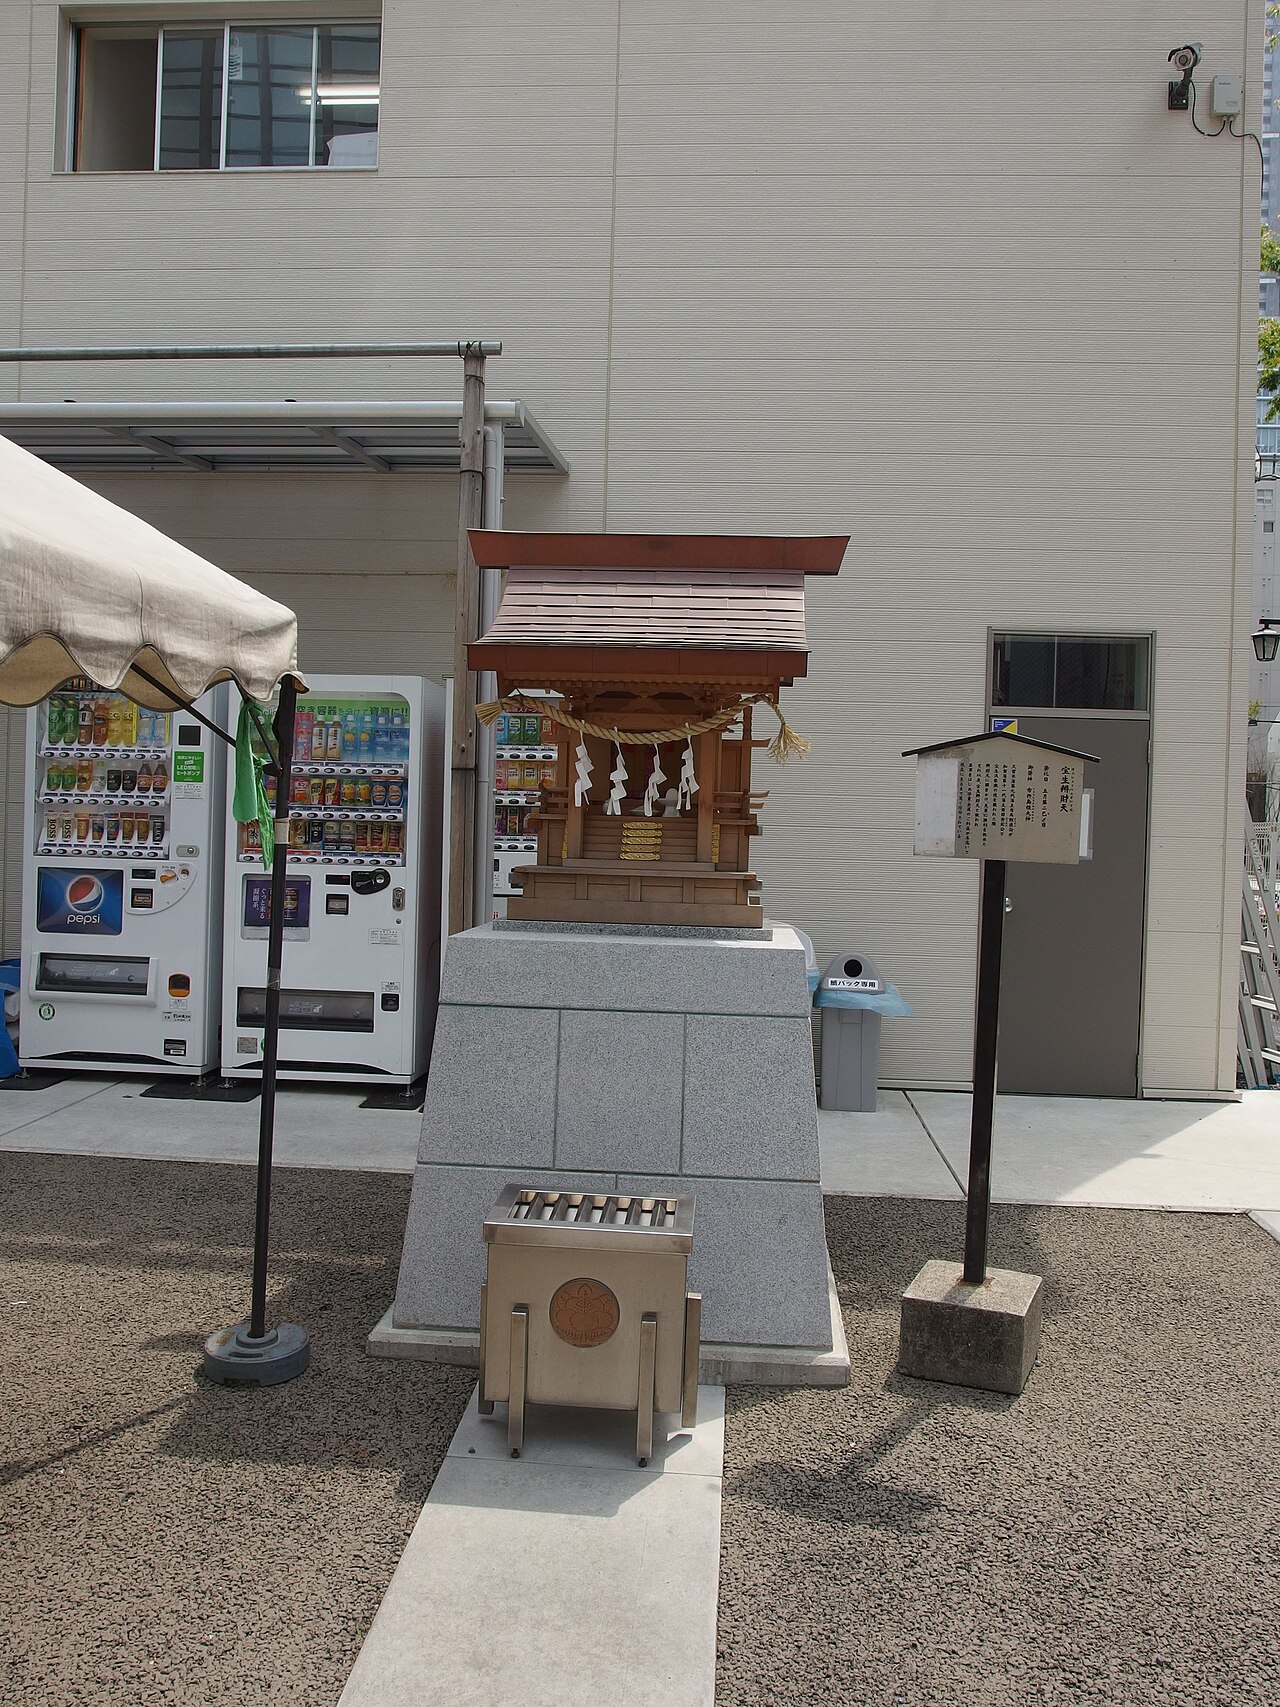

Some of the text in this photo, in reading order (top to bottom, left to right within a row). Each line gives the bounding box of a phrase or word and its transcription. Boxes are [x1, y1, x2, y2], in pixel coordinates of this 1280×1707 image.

[49, 819, 57, 839] BOSS
[64, 819, 72, 839] BOSS
[67, 913, 101, 925] pepsi
[830, 980, 876, 988] 紙パック専用
